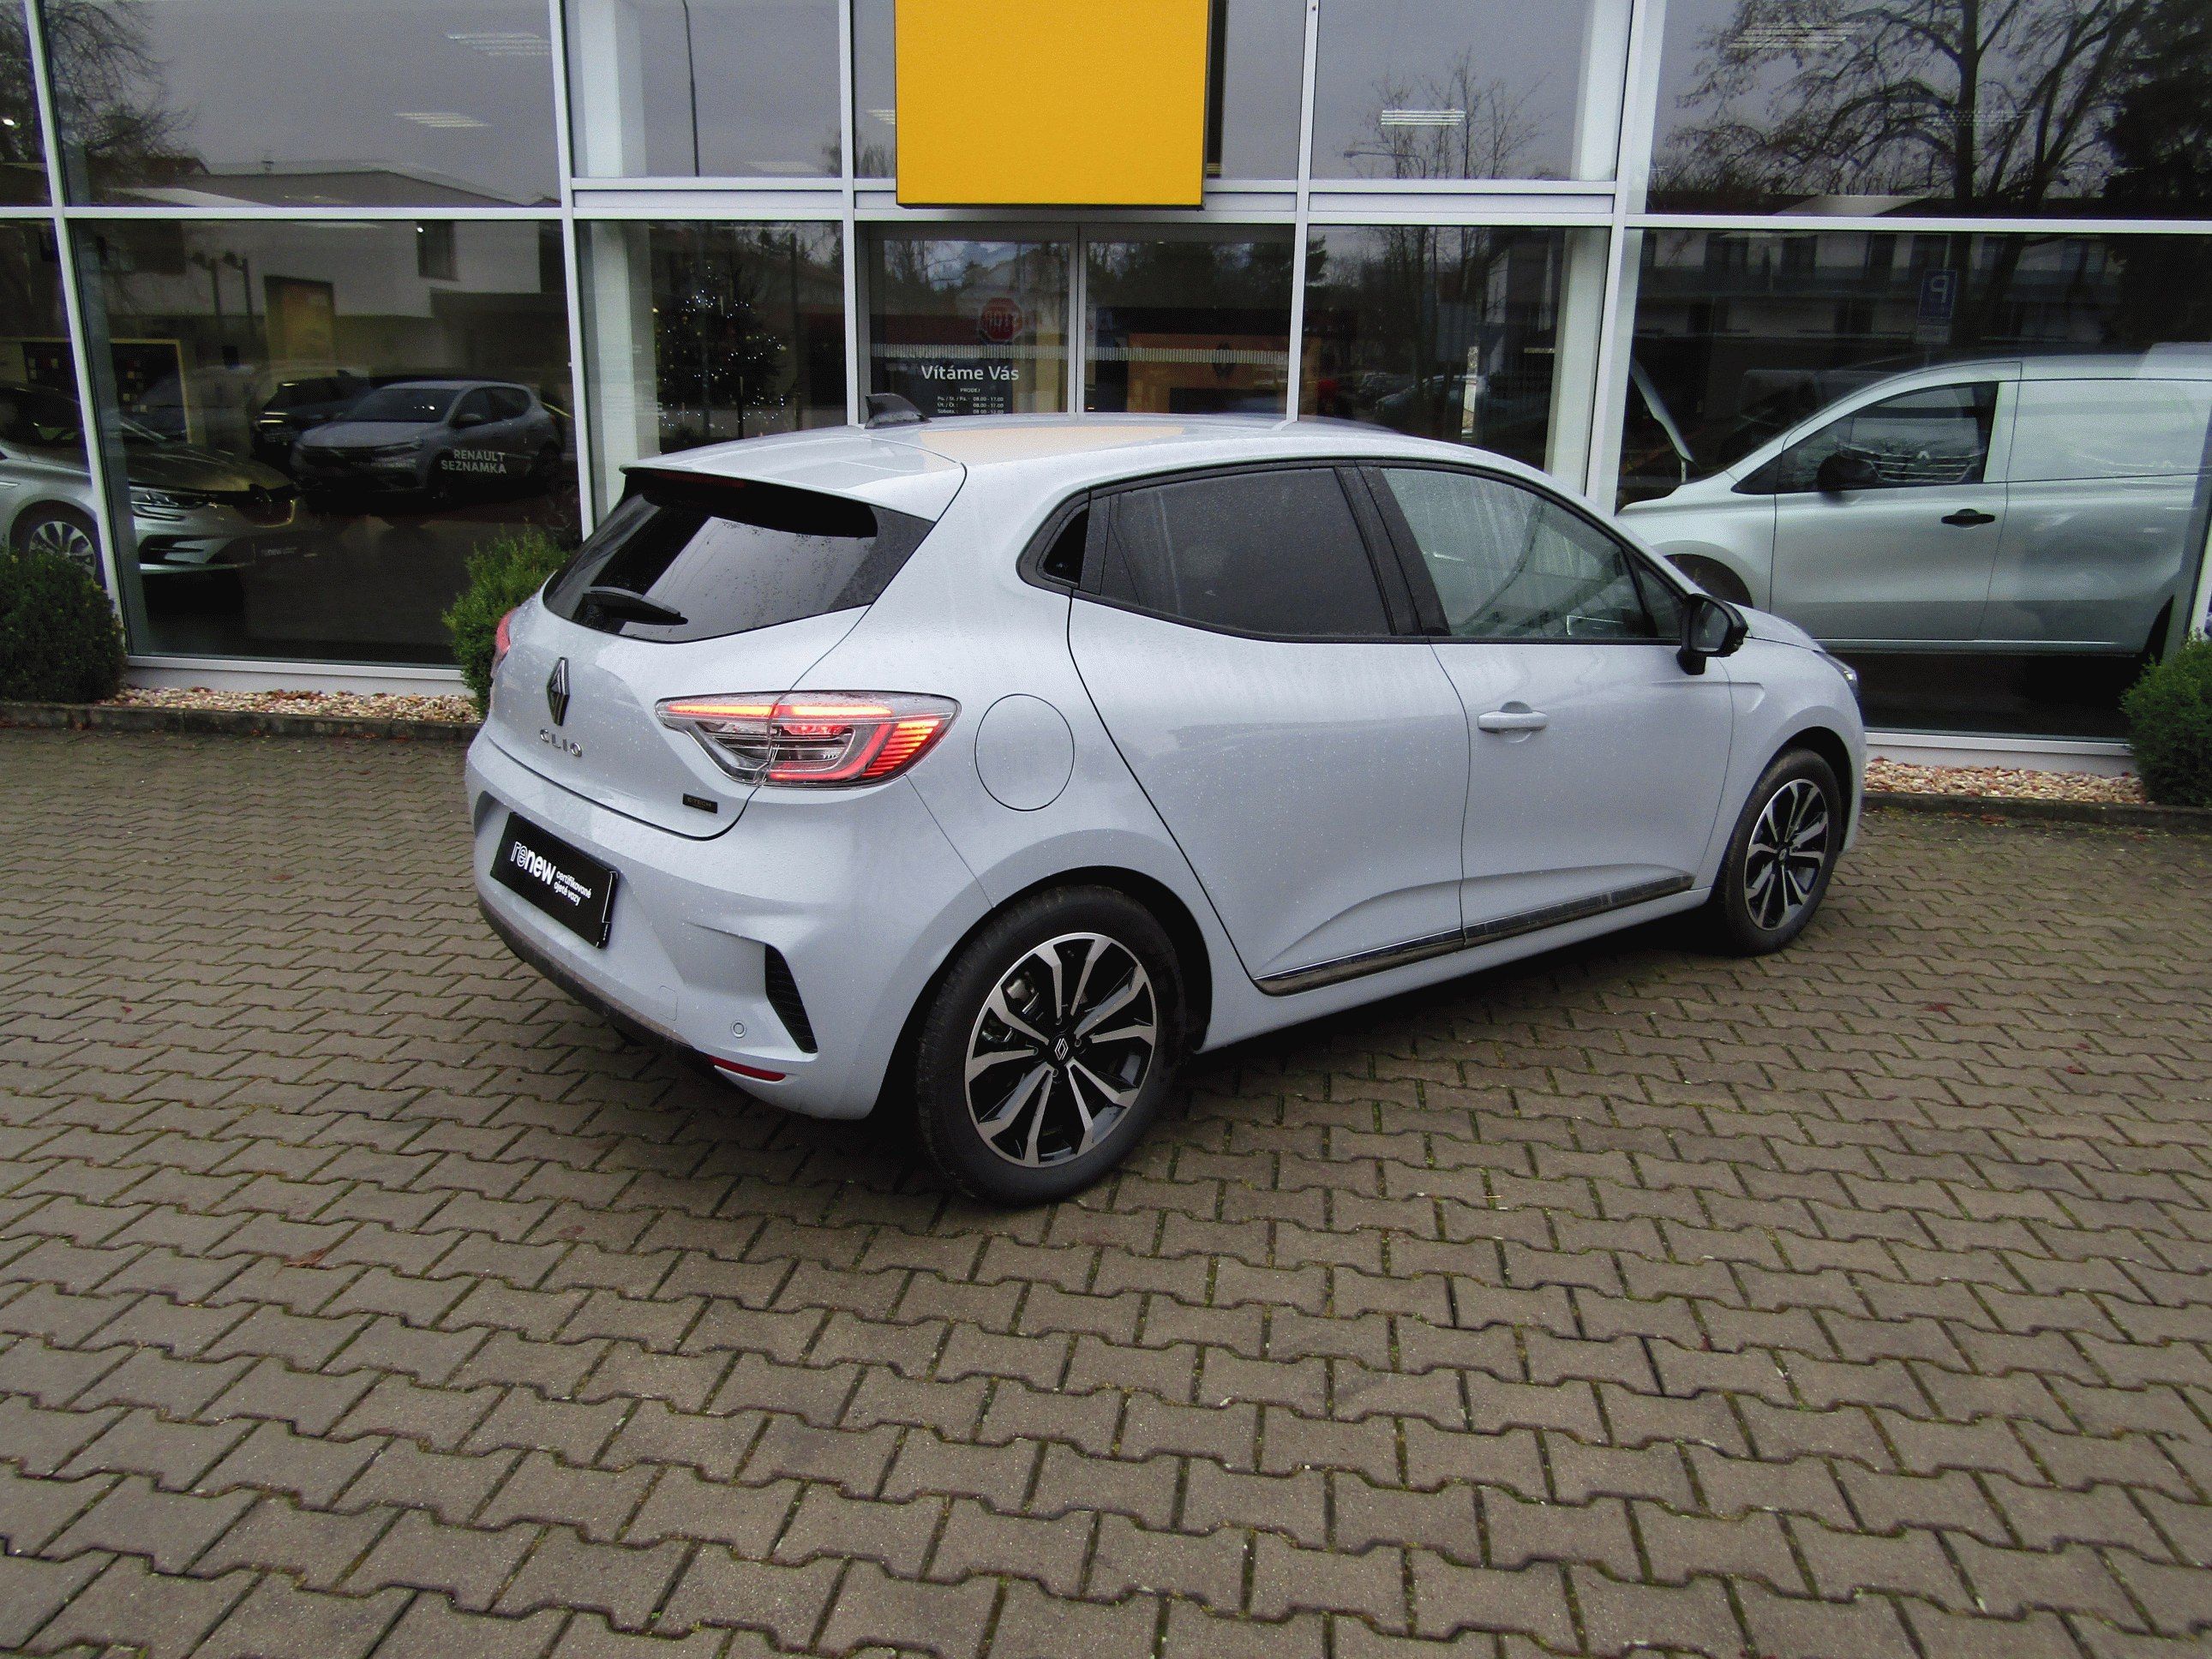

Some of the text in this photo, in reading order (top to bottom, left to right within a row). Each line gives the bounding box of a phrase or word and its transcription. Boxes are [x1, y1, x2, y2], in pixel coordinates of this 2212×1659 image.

[920, 364, 1020, 380] Vítáme Vás
[441, 459, 507, 474] SEZNAMKA
[453, 449, 506, 462] RENAULT
[539, 728, 583, 758] CLIO
[510, 841, 557, 885] renew
[554, 881, 582, 907] ojeté vozy
[555, 870, 592, 899] certifikované
